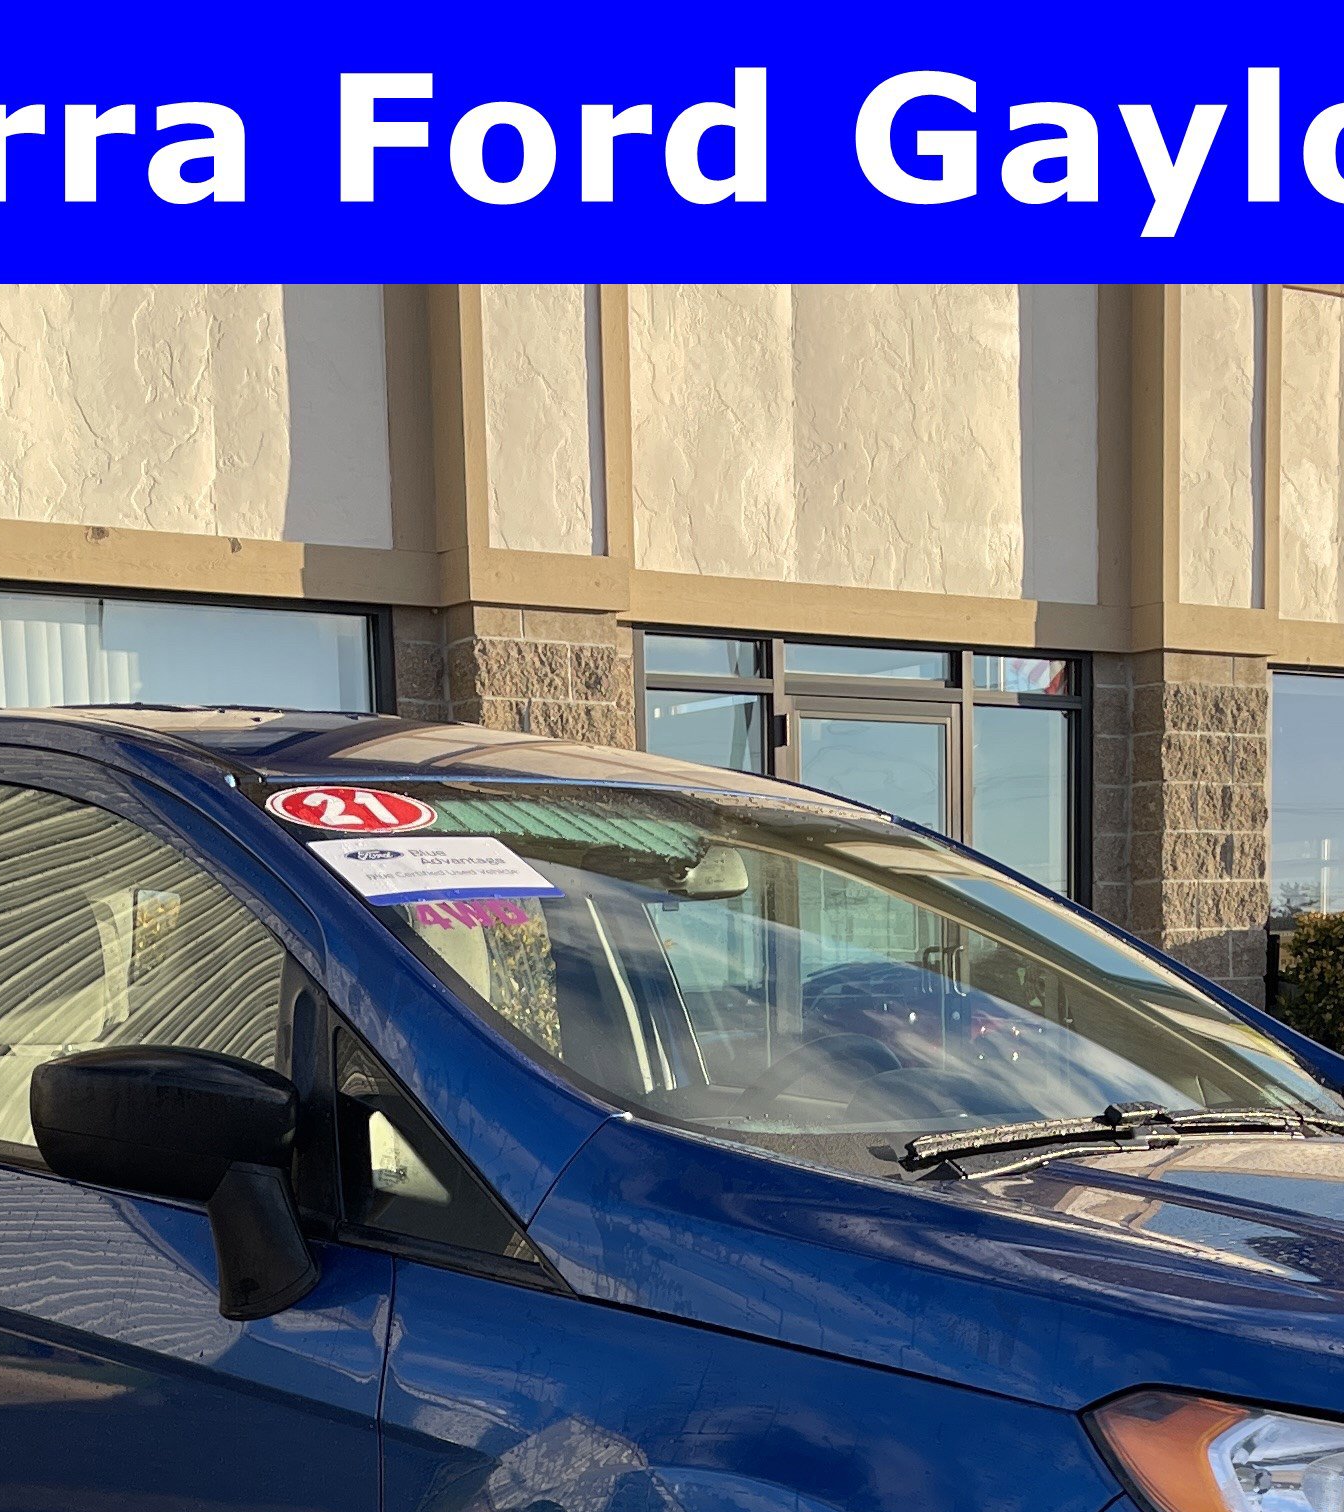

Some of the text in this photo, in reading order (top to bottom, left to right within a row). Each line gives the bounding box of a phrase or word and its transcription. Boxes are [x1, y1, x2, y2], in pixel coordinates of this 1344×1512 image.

[303, 792, 399, 825] 21
[408, 849, 447, 857] Blue
[420, 857, 506, 866] Advantage
[416, 900, 529, 931] 4WD
